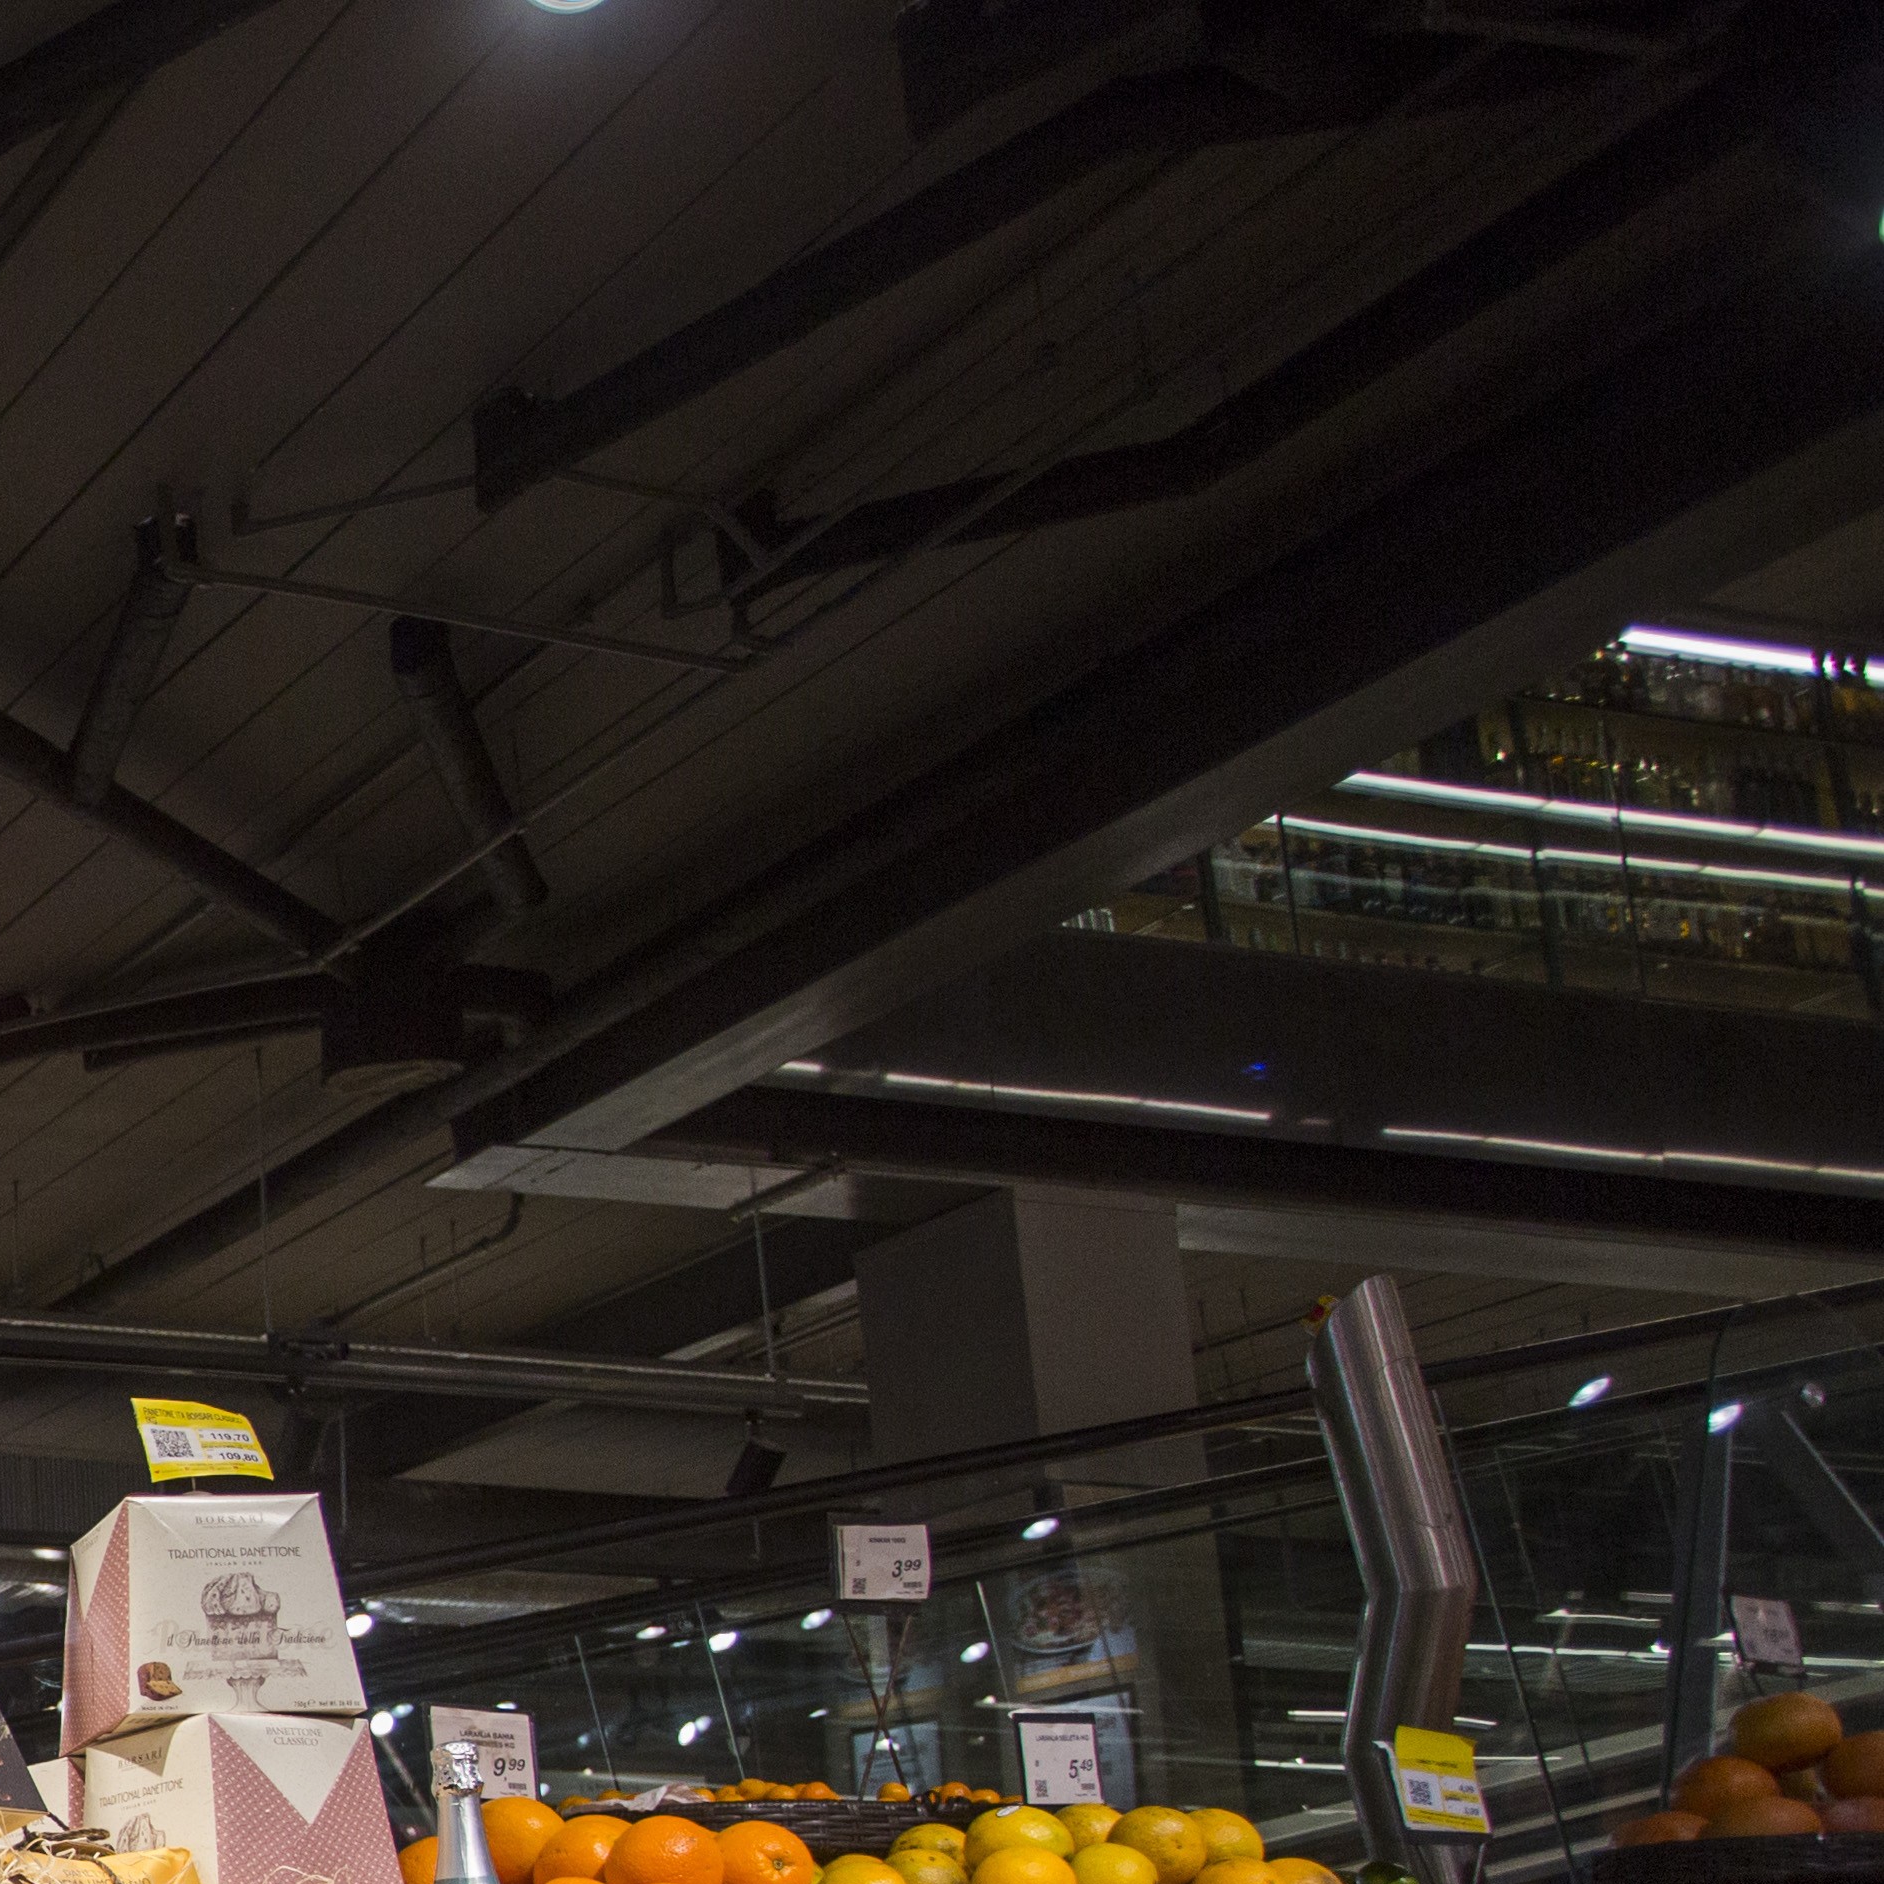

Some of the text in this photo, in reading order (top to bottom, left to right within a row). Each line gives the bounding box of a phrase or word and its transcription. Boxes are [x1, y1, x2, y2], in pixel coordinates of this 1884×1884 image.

[211, 1432, 250, 1442] 119,70
[220, 1452, 258, 1462] 109,80
[167, 1548, 237, 1560] TRADITIONAL
[273, 1737, 318, 1747] CLASSICO
